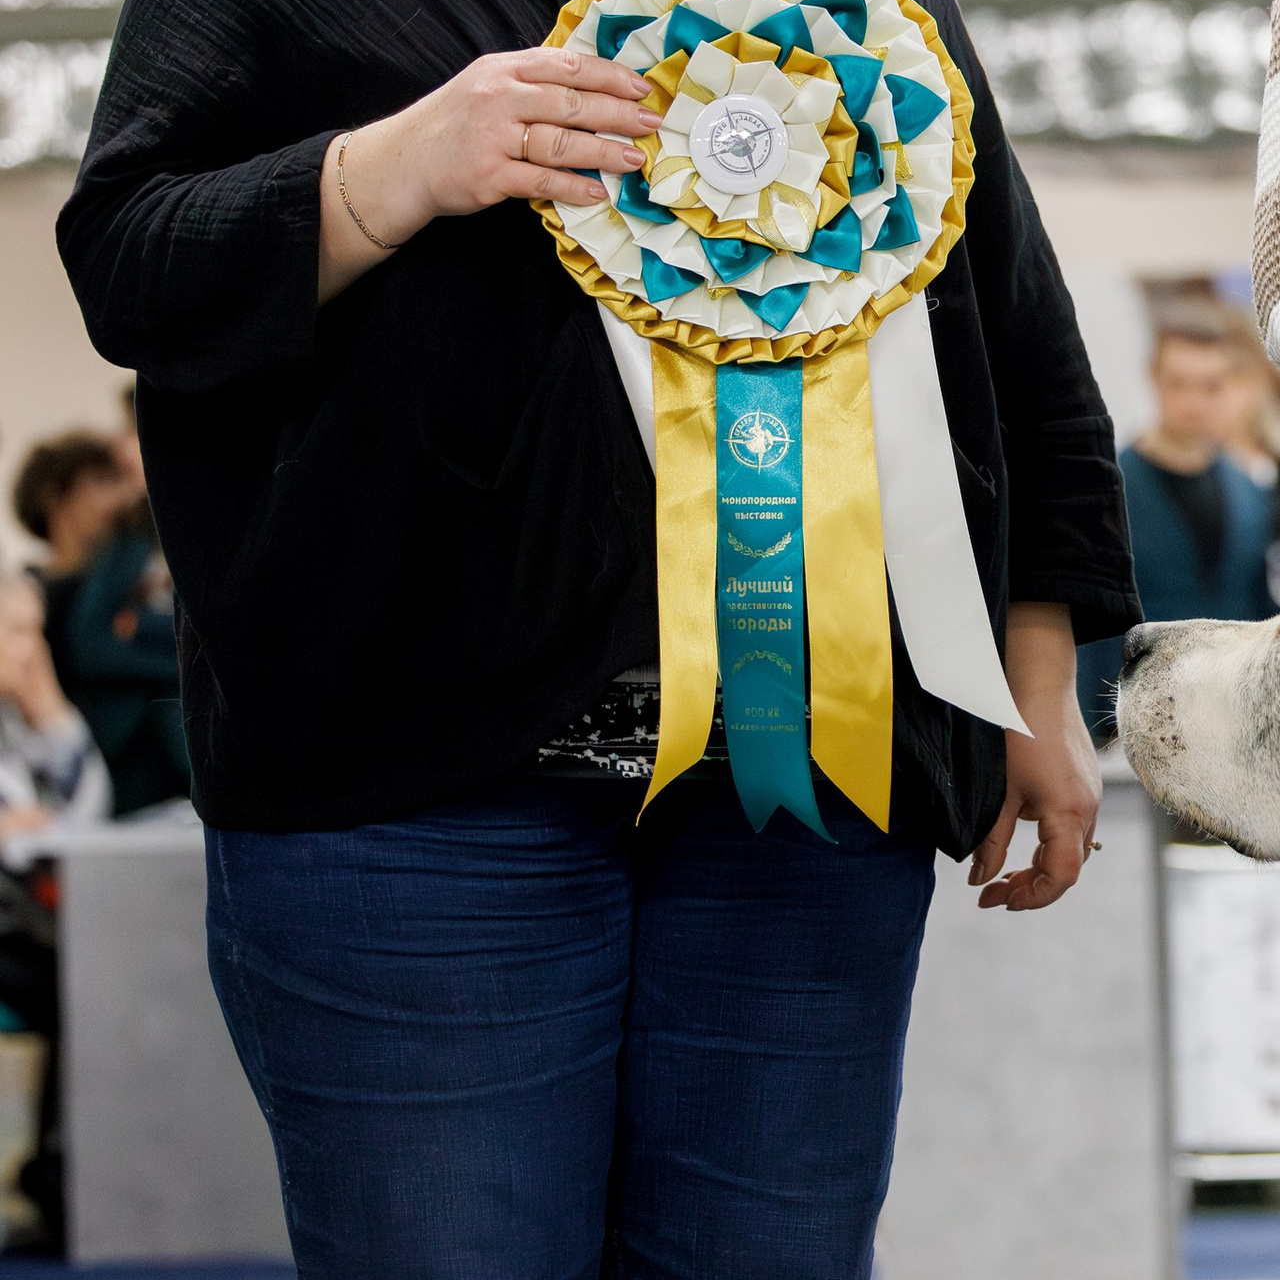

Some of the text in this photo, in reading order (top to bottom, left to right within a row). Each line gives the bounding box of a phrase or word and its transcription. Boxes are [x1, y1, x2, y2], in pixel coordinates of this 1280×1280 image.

[721, 496, 797, 507] монопородная
[734, 511, 784, 520] выставка
[726, 575, 793, 598] Лучший
